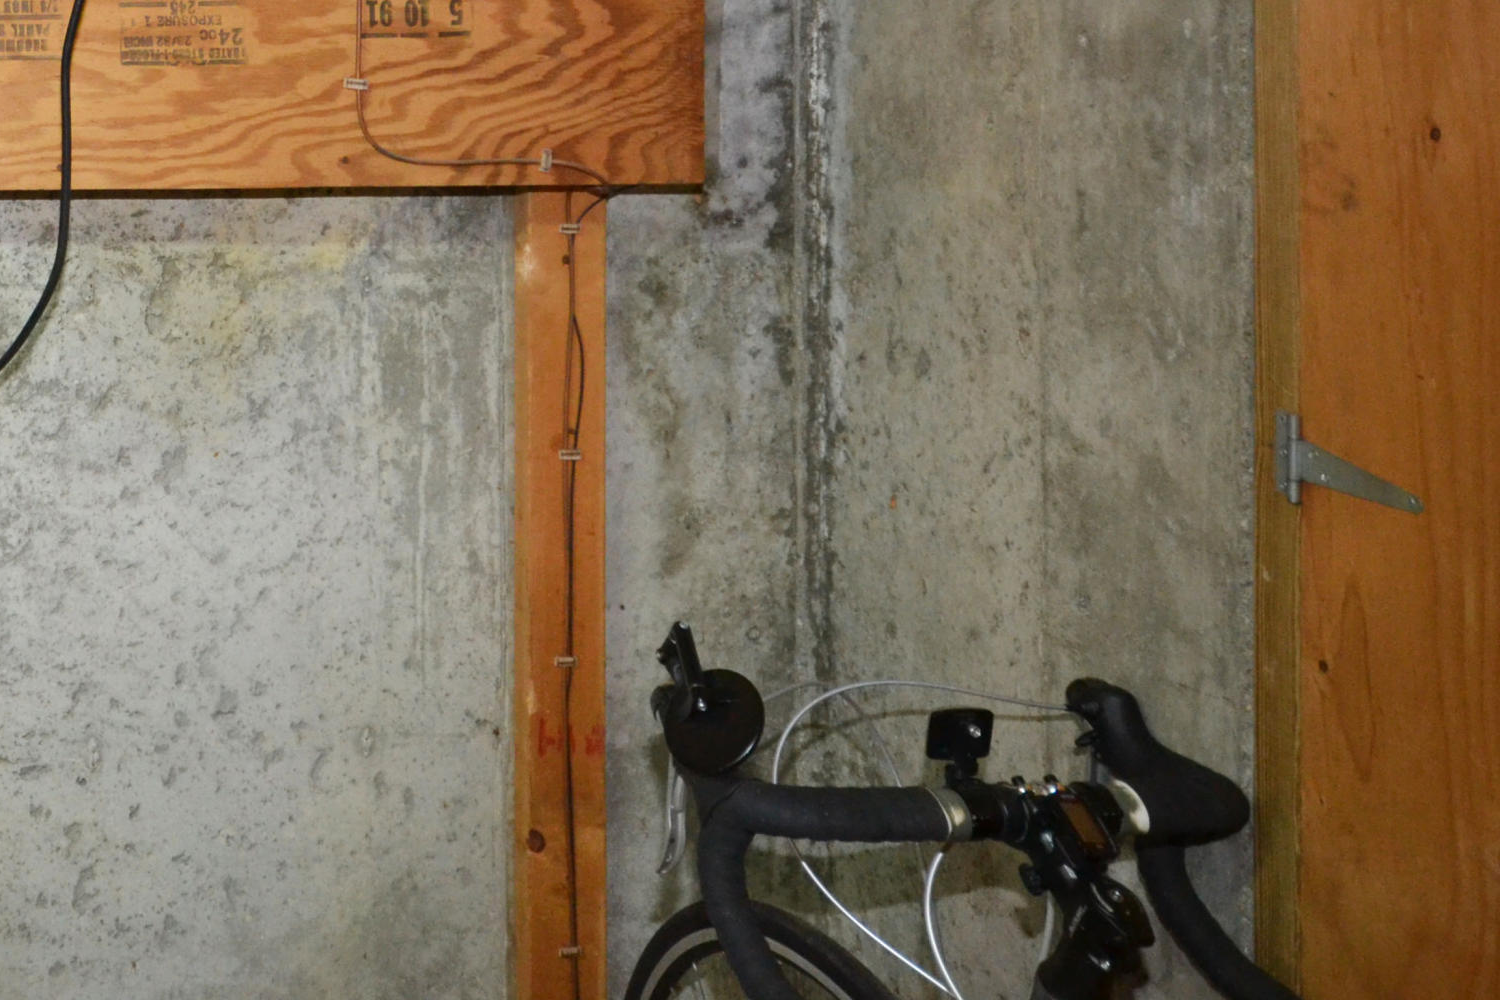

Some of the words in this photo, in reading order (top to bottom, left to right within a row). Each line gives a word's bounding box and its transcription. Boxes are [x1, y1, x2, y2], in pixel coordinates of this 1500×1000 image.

[156, 15, 222, 27] EXPOSURE
[365, 0, 392, 28] 91
[404, 0, 429, 27] 10
[218, 27, 244, 46] 24
